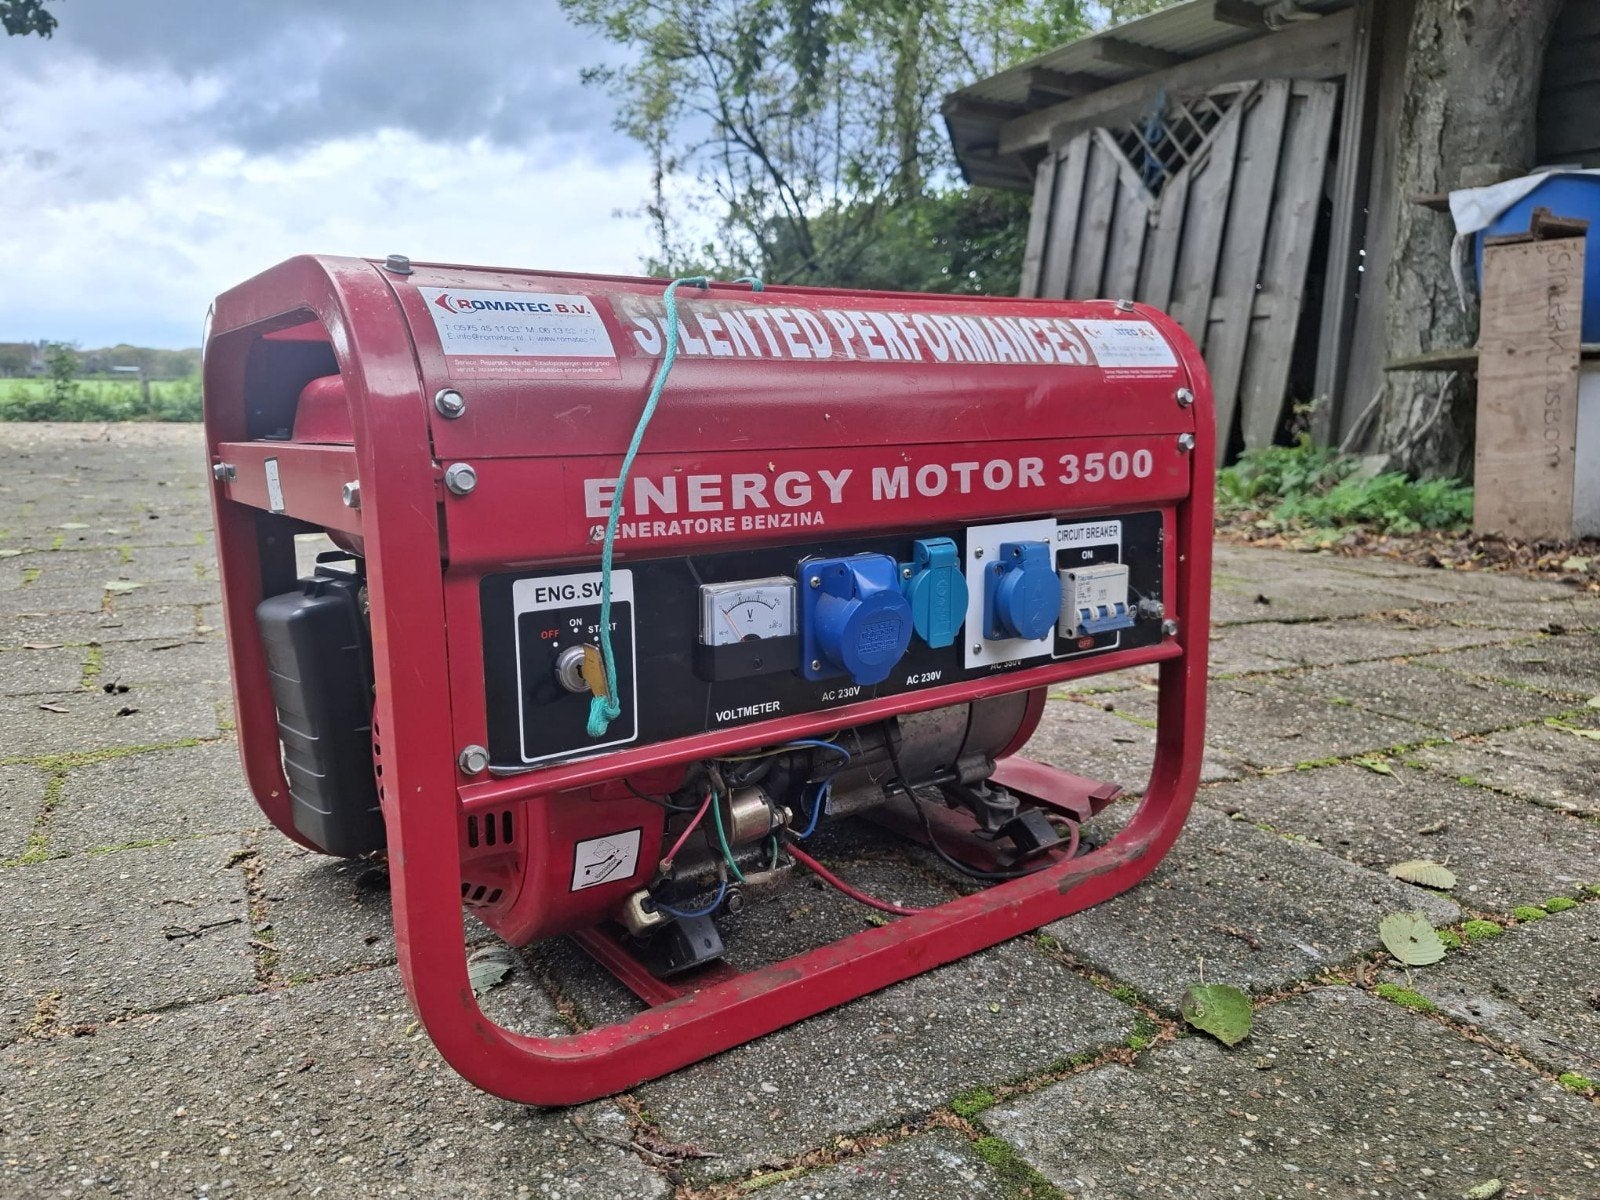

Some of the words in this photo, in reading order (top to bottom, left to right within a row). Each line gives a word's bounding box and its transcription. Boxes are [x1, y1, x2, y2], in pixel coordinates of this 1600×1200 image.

[456, 298, 551, 313] ROMATEC
[556, 303, 591, 315] B.V.
[821, 309, 1090, 366] PERFORMANCES
[584, 469, 853, 518] ENERGY
[871, 456, 1046, 501] MOTOR
[1058, 449, 1153, 485] 3500
[741, 510, 825, 531] BENZINA
[1056, 528, 1085, 542] CIRCUIT
[1085, 525, 1118, 539] BREAKER
[1081, 549, 1094, 560] ON
[568, 617, 583, 627] ON
[587, 622, 617, 634] STT
[540, 629, 560, 640] OFF
[906, 674, 920, 686] AC
[920, 670, 942, 684] 230V
[821, 690, 836, 702] AC
[837, 685, 861, 699] 230V
[715, 700, 781, 723] VOLTMETER
